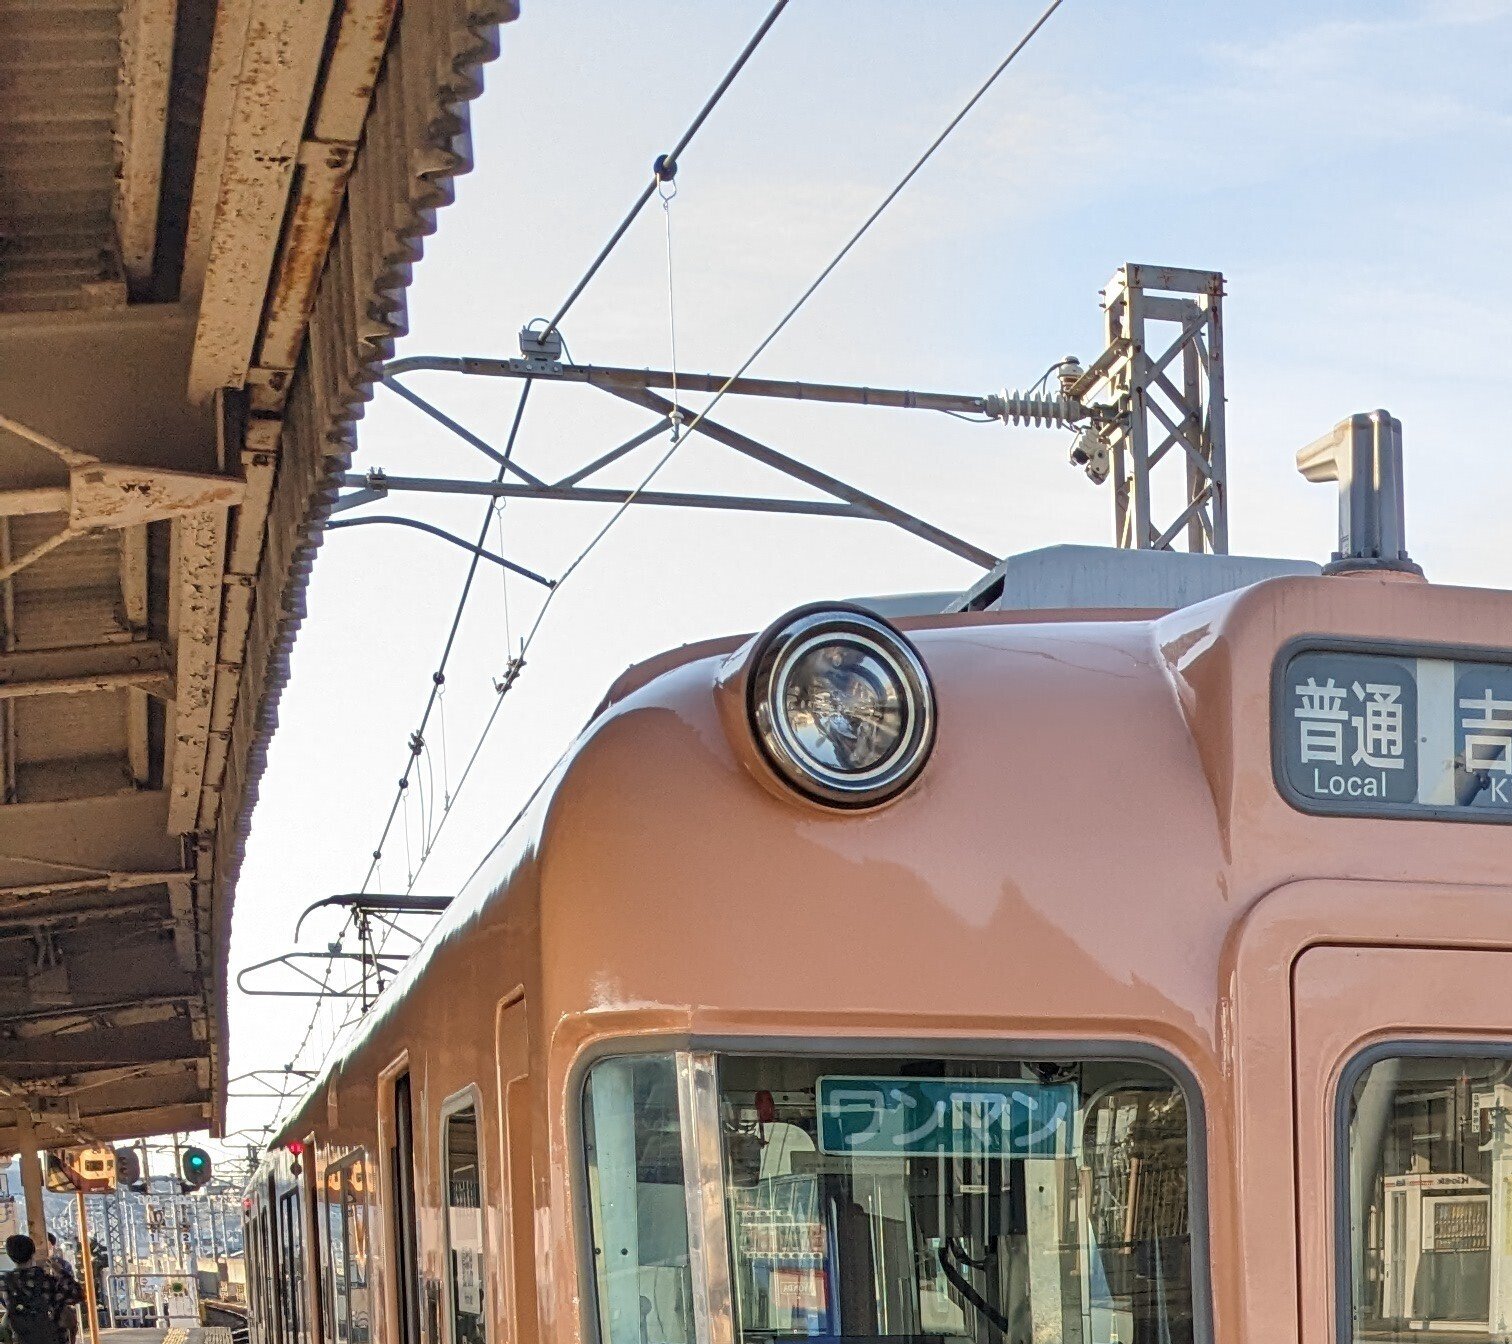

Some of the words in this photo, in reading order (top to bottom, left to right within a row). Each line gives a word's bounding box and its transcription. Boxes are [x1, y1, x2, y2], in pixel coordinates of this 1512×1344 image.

[1294, 676, 1405, 770] 普通
[1313, 768, 1387, 798] Local
[830, 1088, 1068, 1146] ワンマン
[182, 1233, 190, 1242] 2
